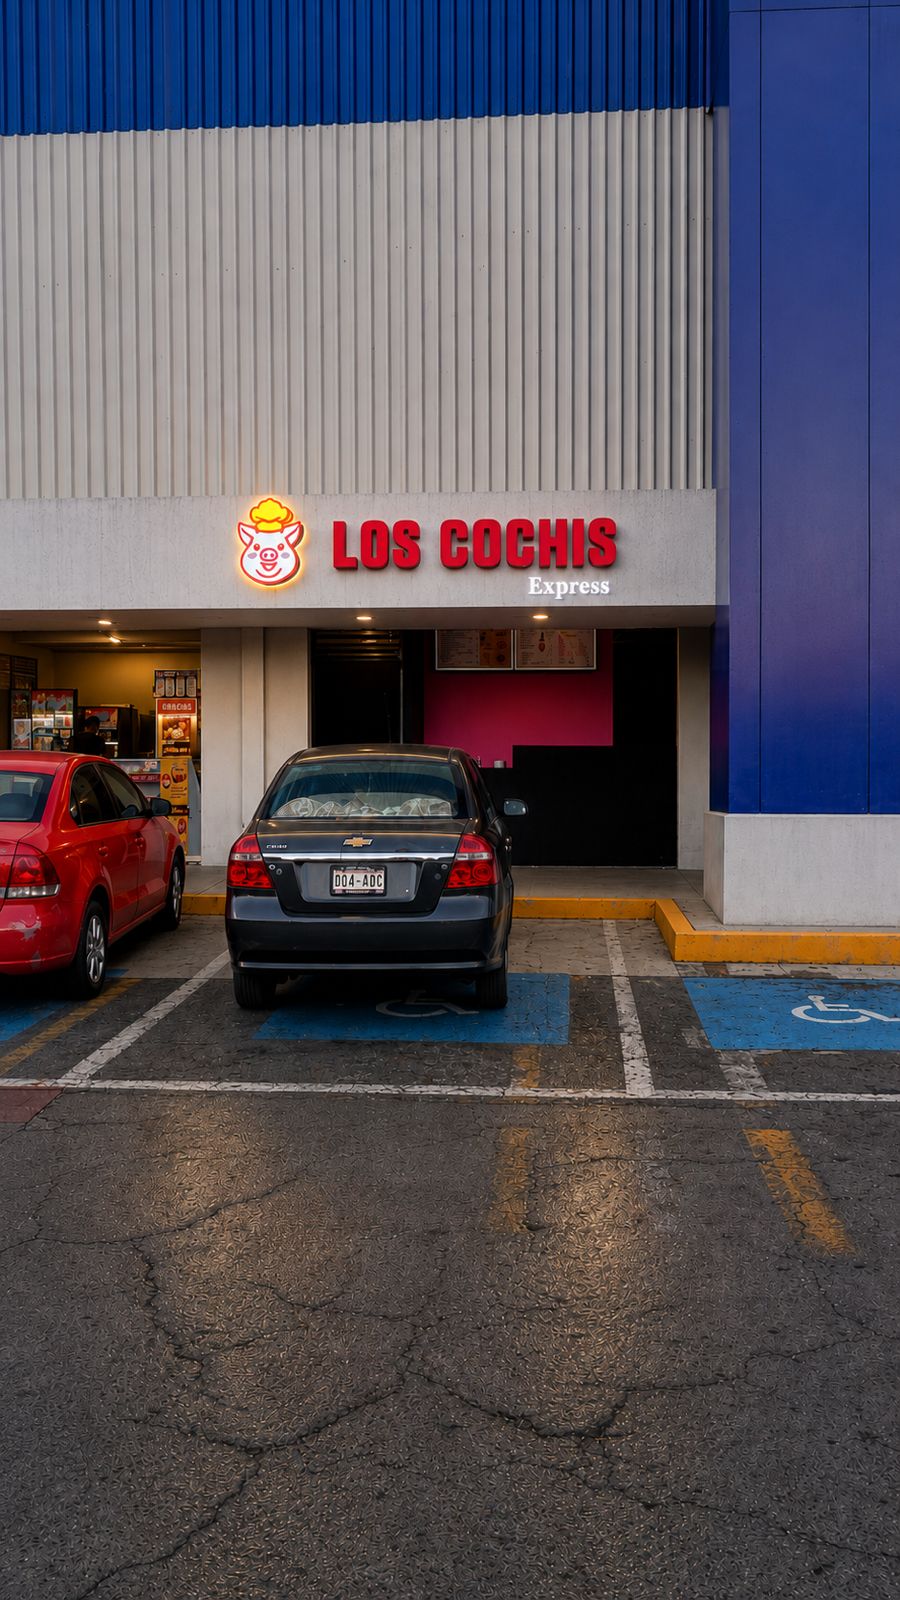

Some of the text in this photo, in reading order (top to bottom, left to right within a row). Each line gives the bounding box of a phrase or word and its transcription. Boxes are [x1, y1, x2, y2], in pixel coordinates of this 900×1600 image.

[332, 517, 618, 570] LOS COCHIS
[527, 576, 611, 600] Express
